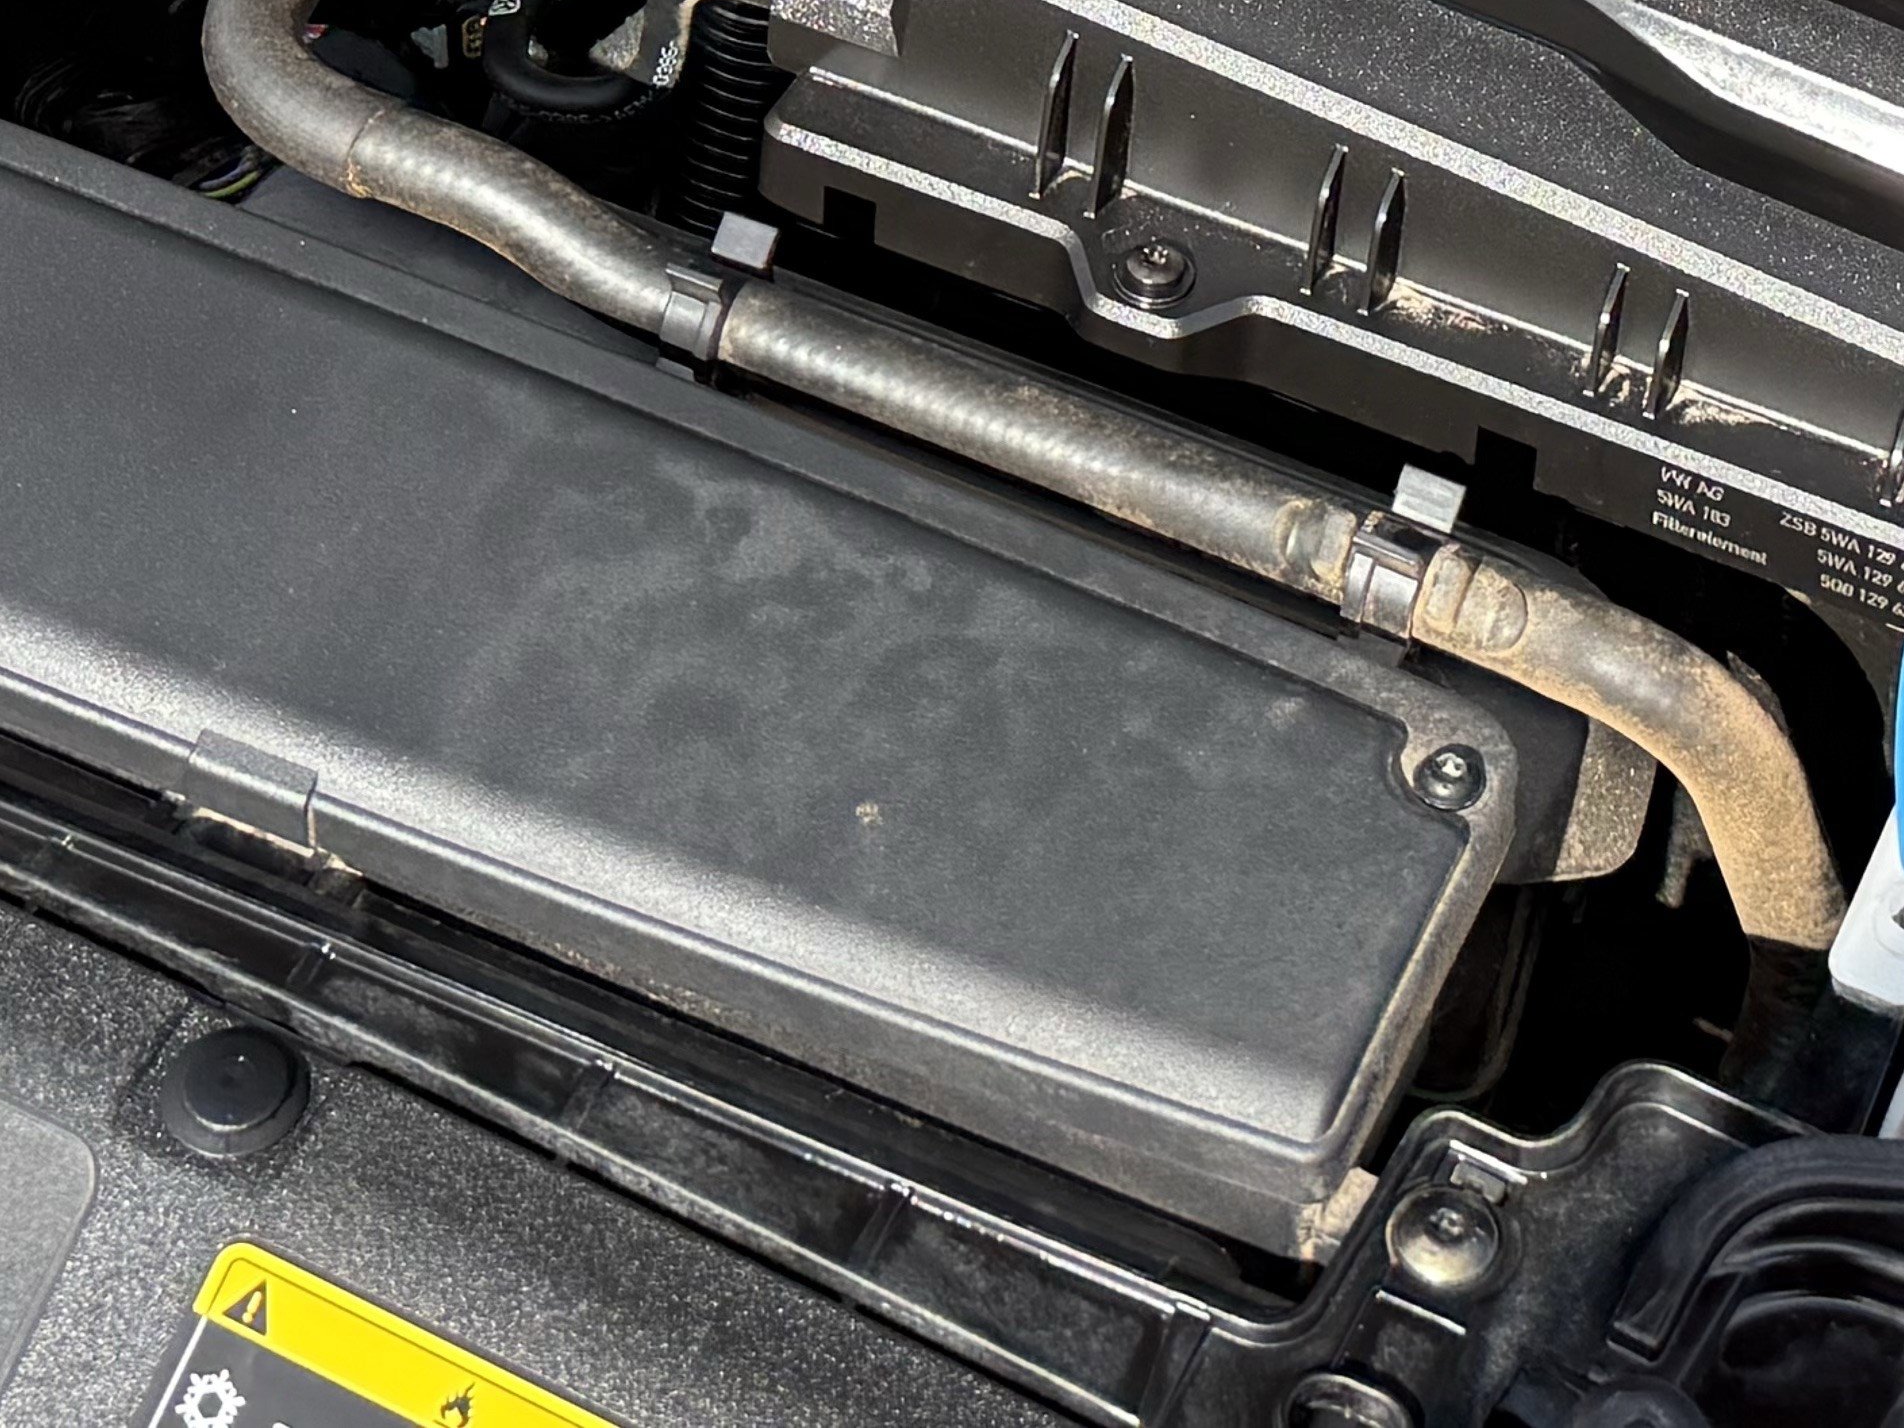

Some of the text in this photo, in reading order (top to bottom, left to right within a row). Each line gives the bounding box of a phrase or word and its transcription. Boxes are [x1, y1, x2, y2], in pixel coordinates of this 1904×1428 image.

[1661, 467, 1725, 501] VW AG
[1657, 489, 1696, 515] 5WA
[1780, 511, 1817, 537] ZSB
[1820, 529, 1860, 555] 5WA
[1867, 544, 1896, 565] 129
[1817, 549, 1857, 576] 5WA
[1864, 566, 1893, 587] 129
[1859, 588, 1889, 610] 129
